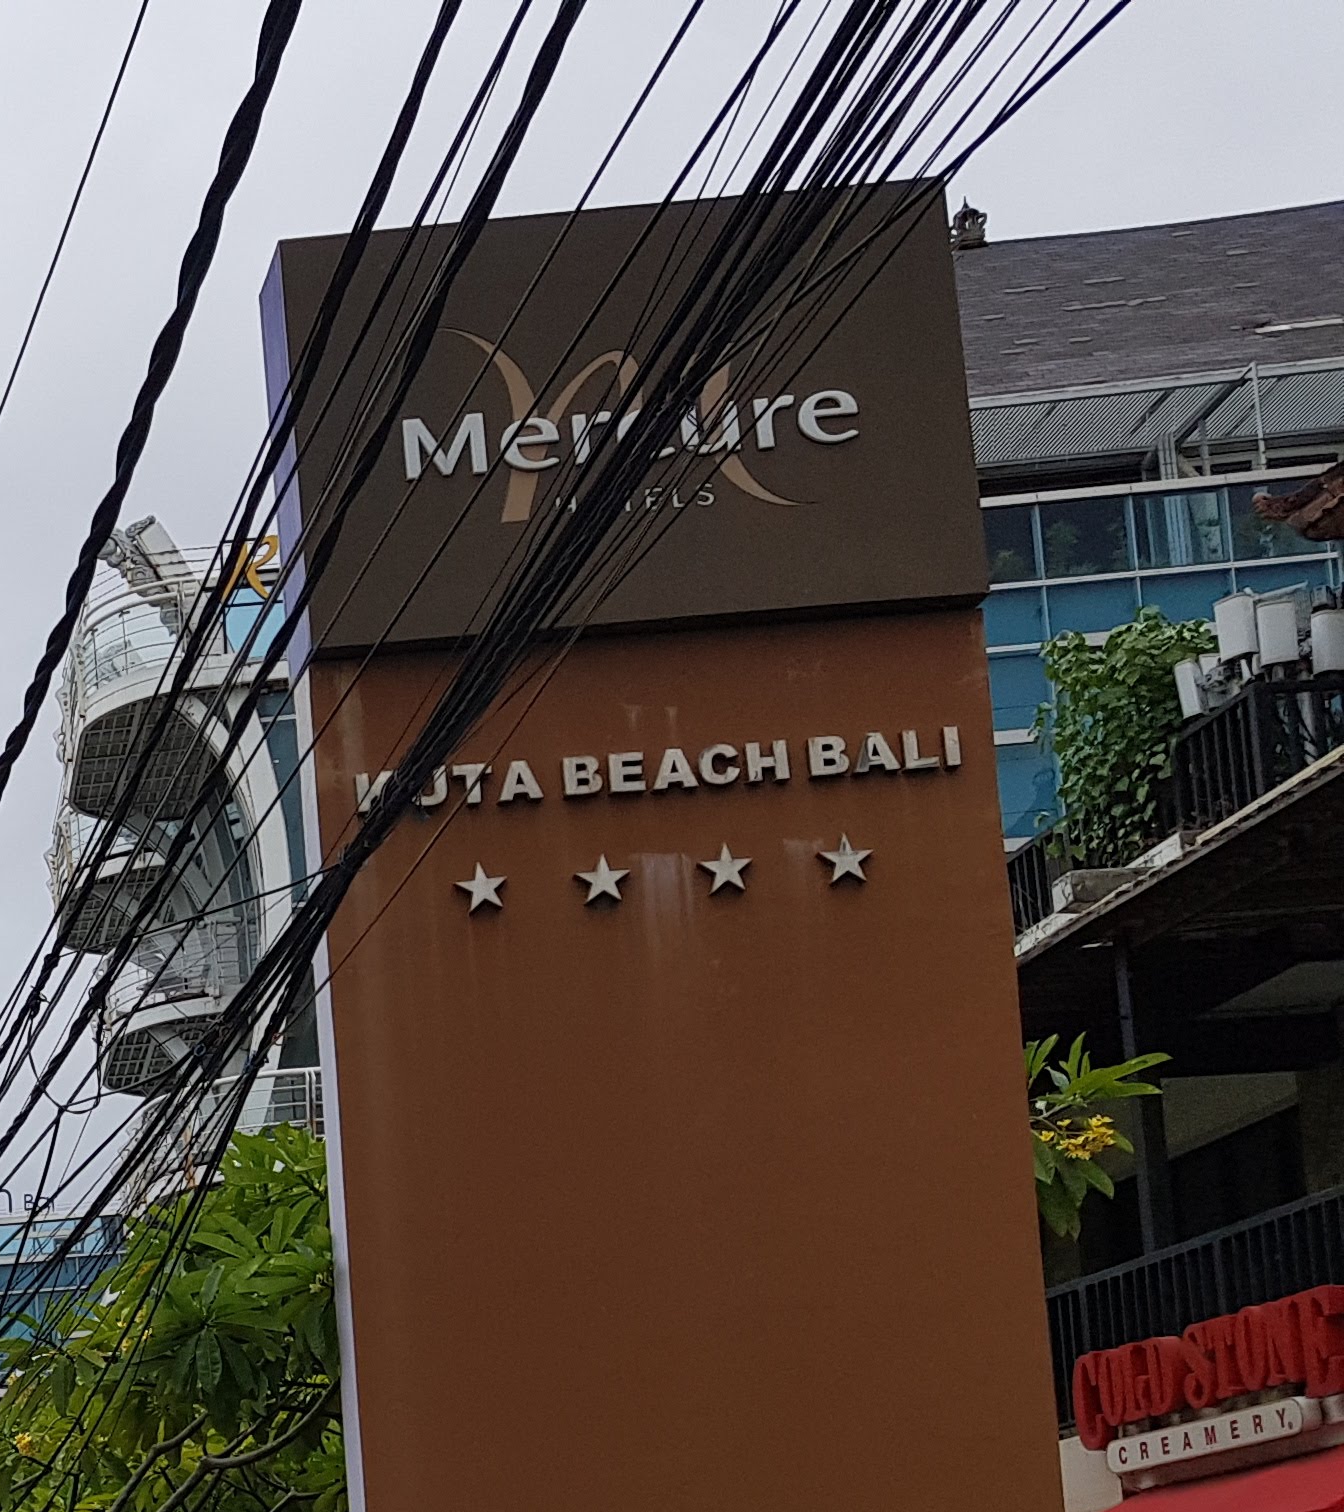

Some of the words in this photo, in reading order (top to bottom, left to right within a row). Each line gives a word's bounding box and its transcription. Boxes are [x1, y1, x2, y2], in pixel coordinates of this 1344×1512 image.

[555, 482, 715, 514] HELS
[562, 739, 791, 798] BEACH
[807, 725, 962, 777] BALI
[1118, 1407, 1289, 1465] CREAMERY
